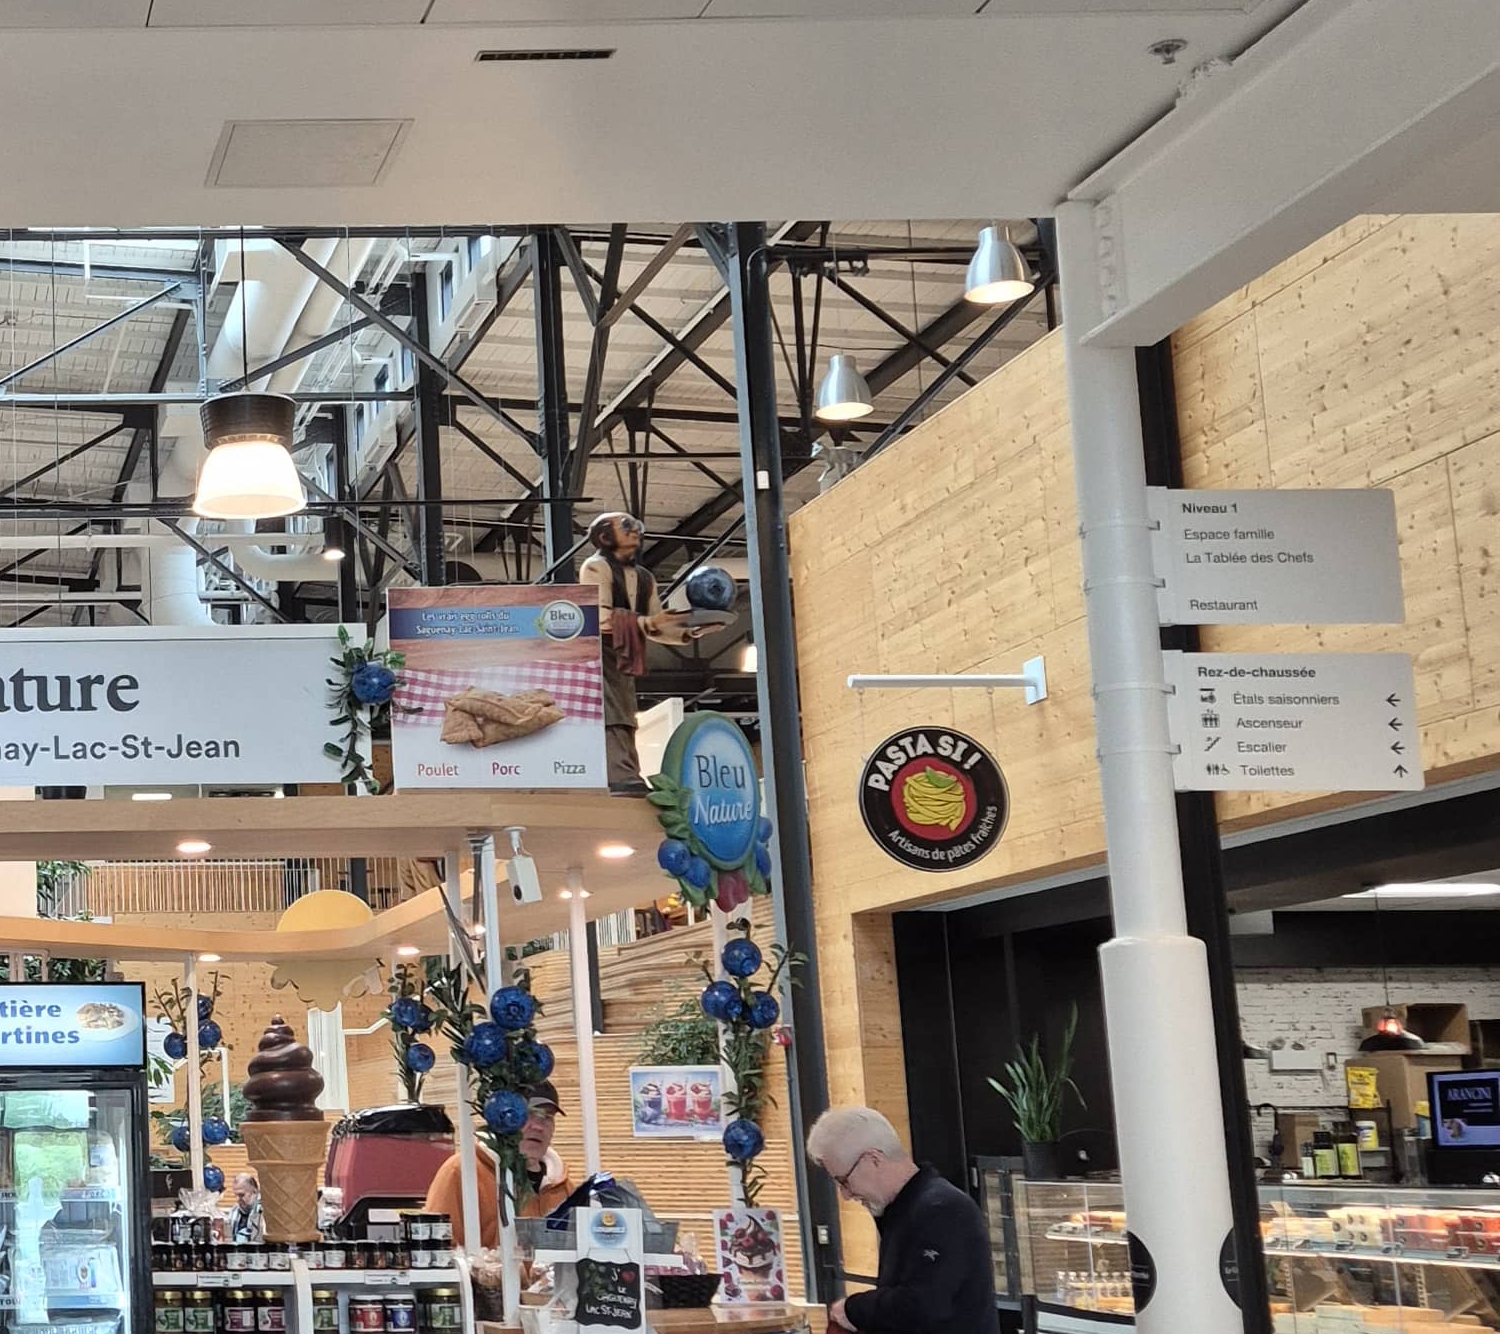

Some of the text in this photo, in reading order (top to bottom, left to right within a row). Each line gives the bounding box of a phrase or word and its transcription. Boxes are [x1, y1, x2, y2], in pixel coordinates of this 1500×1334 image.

[1182, 503, 1238, 513] Niveau 1
[1184, 529, 1275, 541] Espace famille
[1186, 552, 1314, 563] La Tablée des Chefs
[1190, 600, 1258, 611] Restaurant
[550, 610, 576, 621] Bleu
[1198, 667, 1316, 678] Rez-de-chaussée
[1233, 691, 1340, 705] Étals saisonniers
[1236, 718, 1303, 729] Ascenseur
[1237, 741, 1287, 753] Escalier
[492, 762, 520, 775] Porc
[553, 762, 586, 775] Pizza
[868, 733, 935, 792] PASTA
[937, 735, 969, 762] SI
[417, 763, 459, 777] Poulet
[695, 754, 746, 789] Bleu
[1240, 765, 1295, 776] Toilettes
[693, 796, 752, 826] Nature
[888, 805, 998, 863] Artisans de pâtes fraîches
